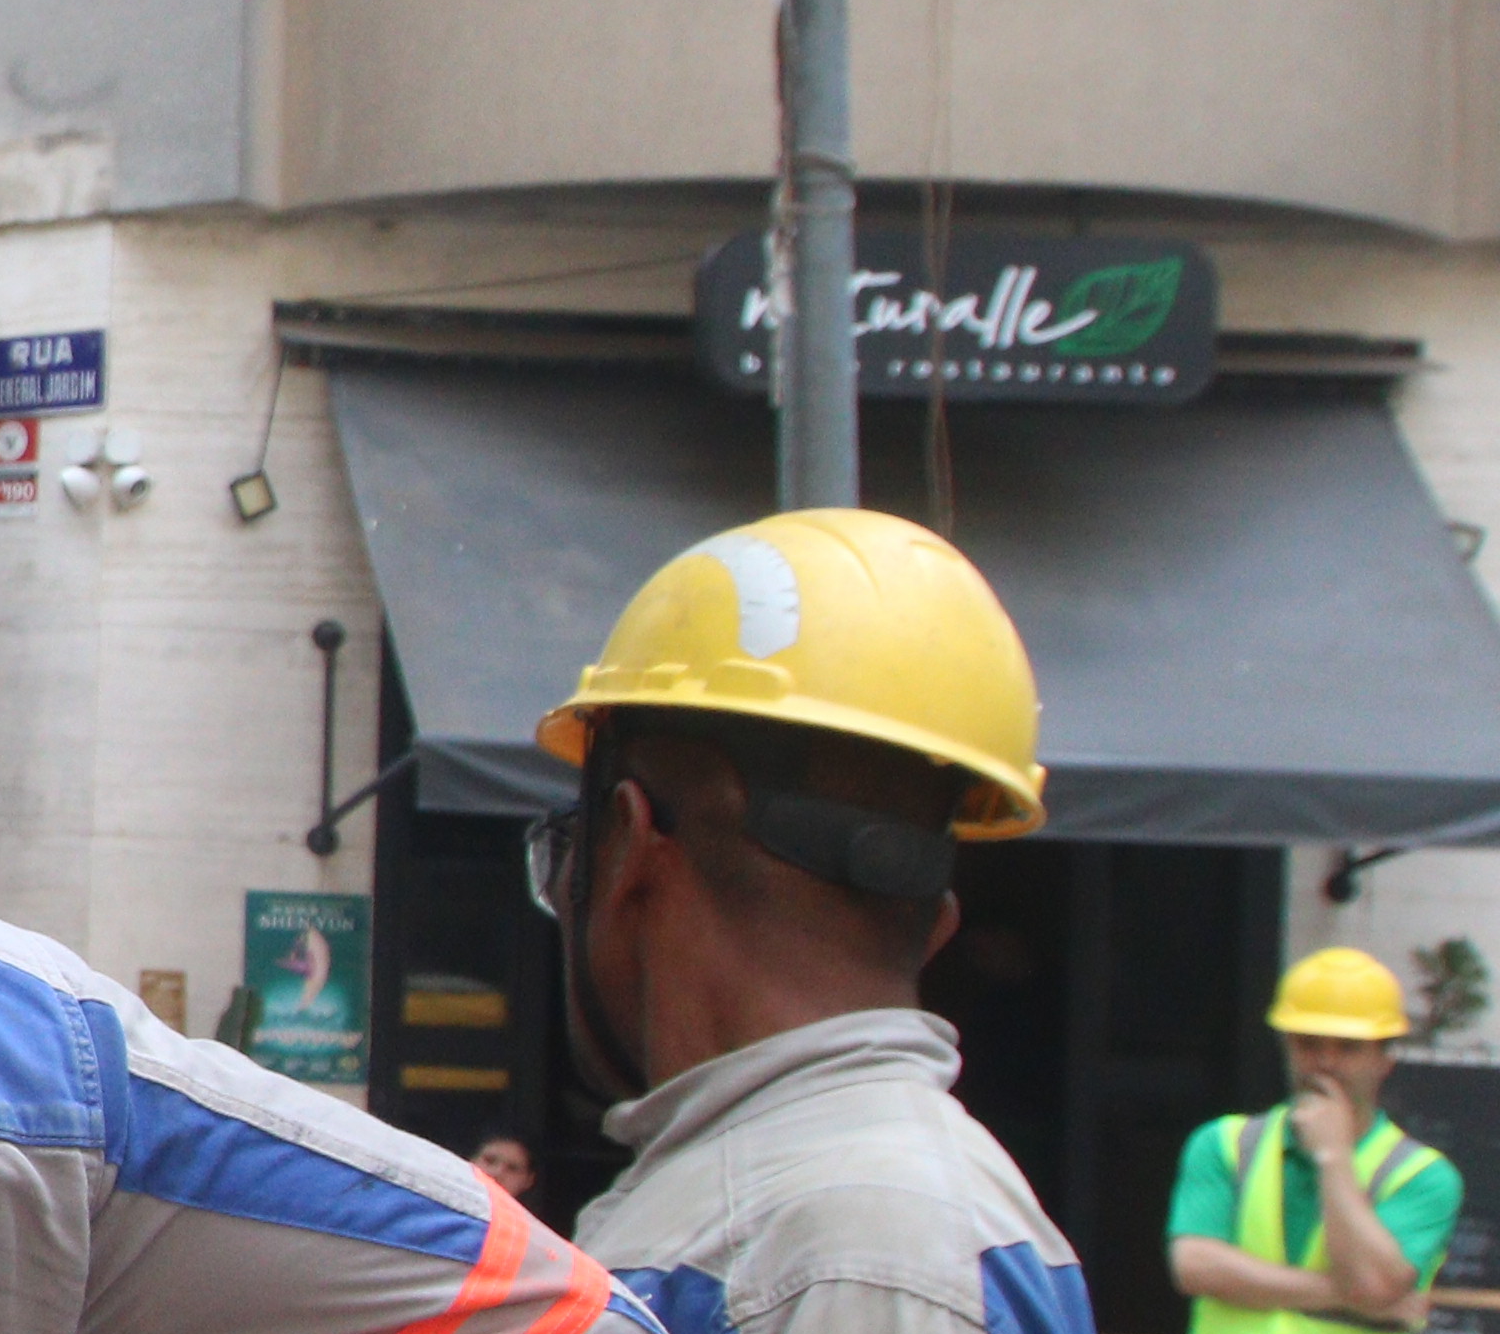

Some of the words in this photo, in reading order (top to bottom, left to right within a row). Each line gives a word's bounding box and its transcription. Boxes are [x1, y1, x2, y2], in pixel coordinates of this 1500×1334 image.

[10, 336, 73, 370] RUA
[45, 370, 96, 403] JARDIM
[259, 915, 311, 931] SHEN
[319, 917, 355, 932] YUN
